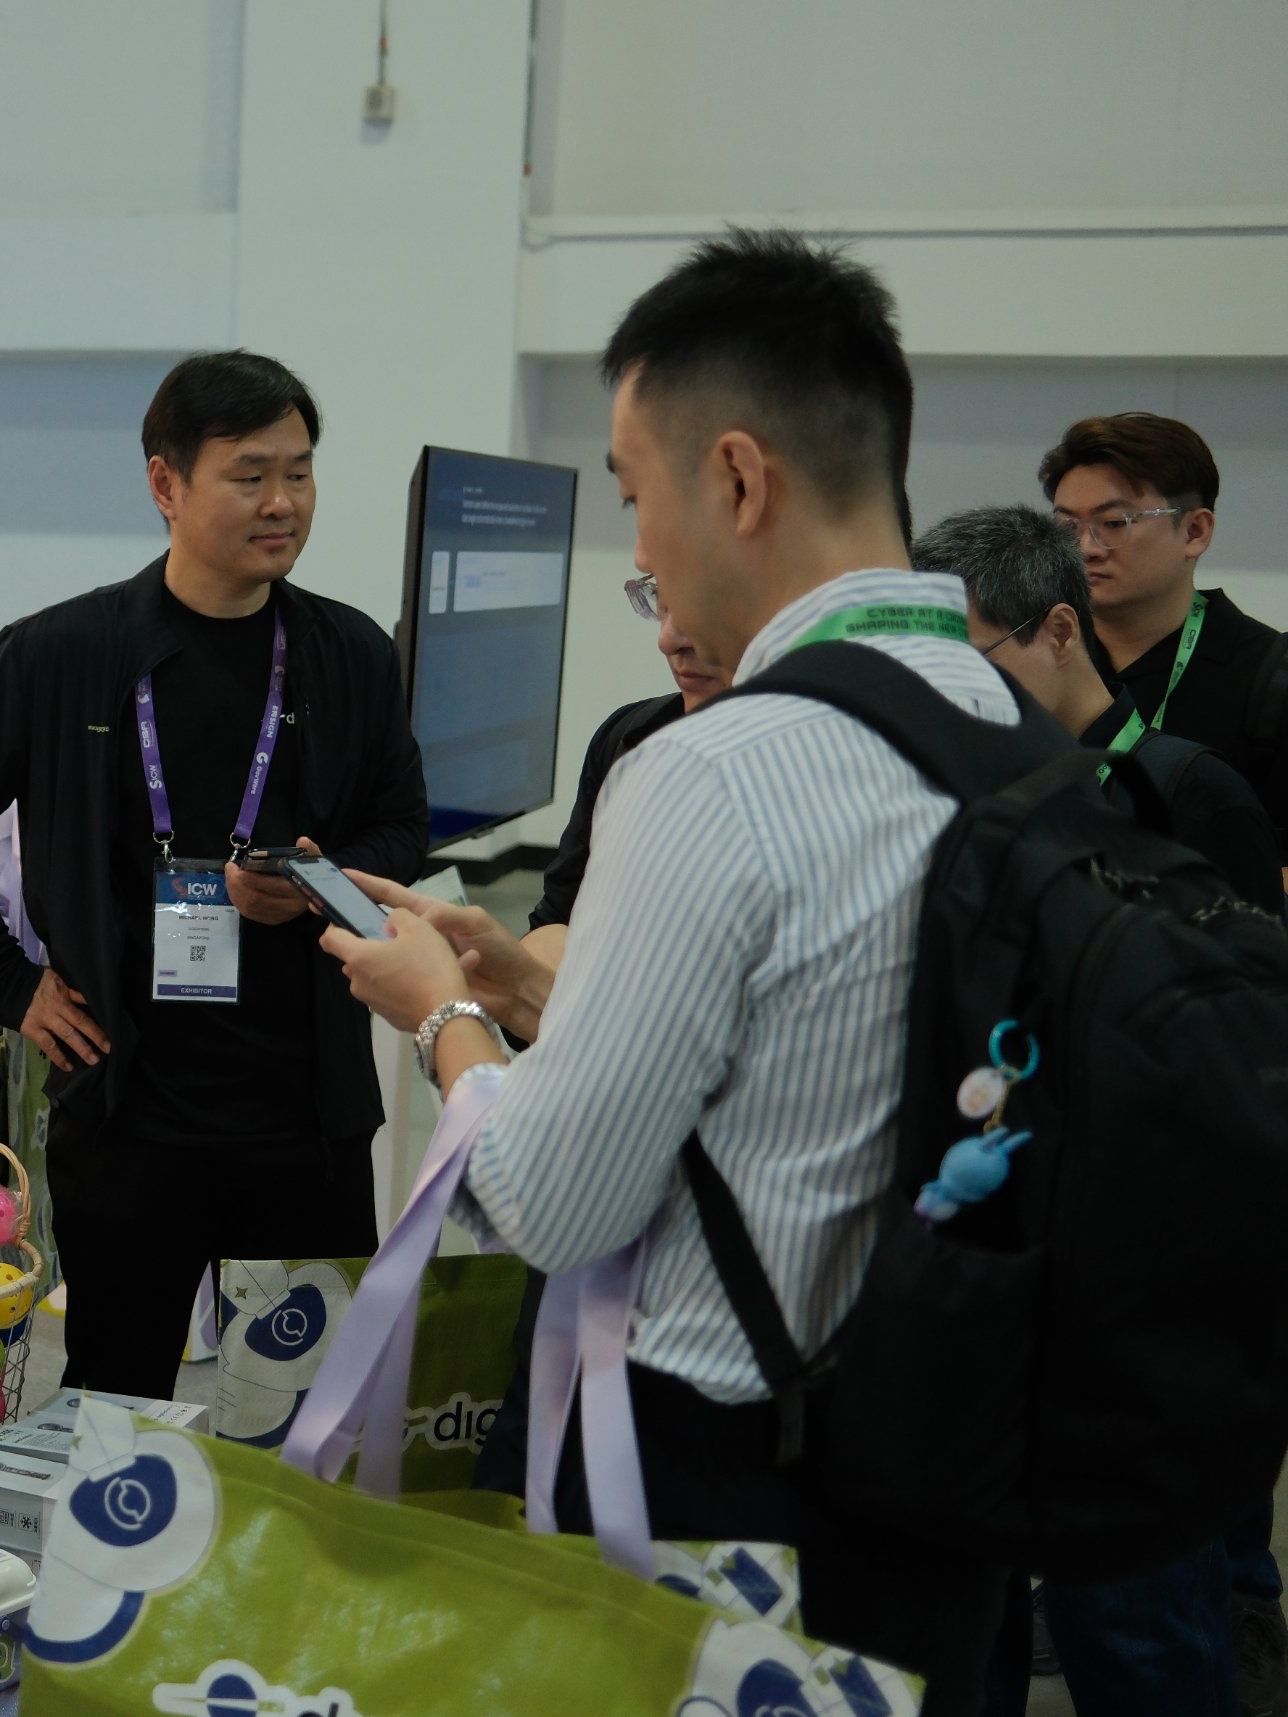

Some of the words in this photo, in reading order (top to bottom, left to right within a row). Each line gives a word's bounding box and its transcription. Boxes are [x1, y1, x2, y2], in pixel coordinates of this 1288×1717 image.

[867, 607, 913, 618] CYBER
[918, 608, 931, 618] AT
[846, 619, 909, 633] SHAPING
[913, 621, 935, 631] THE
[267, 705, 279, 738] ENSIGN
